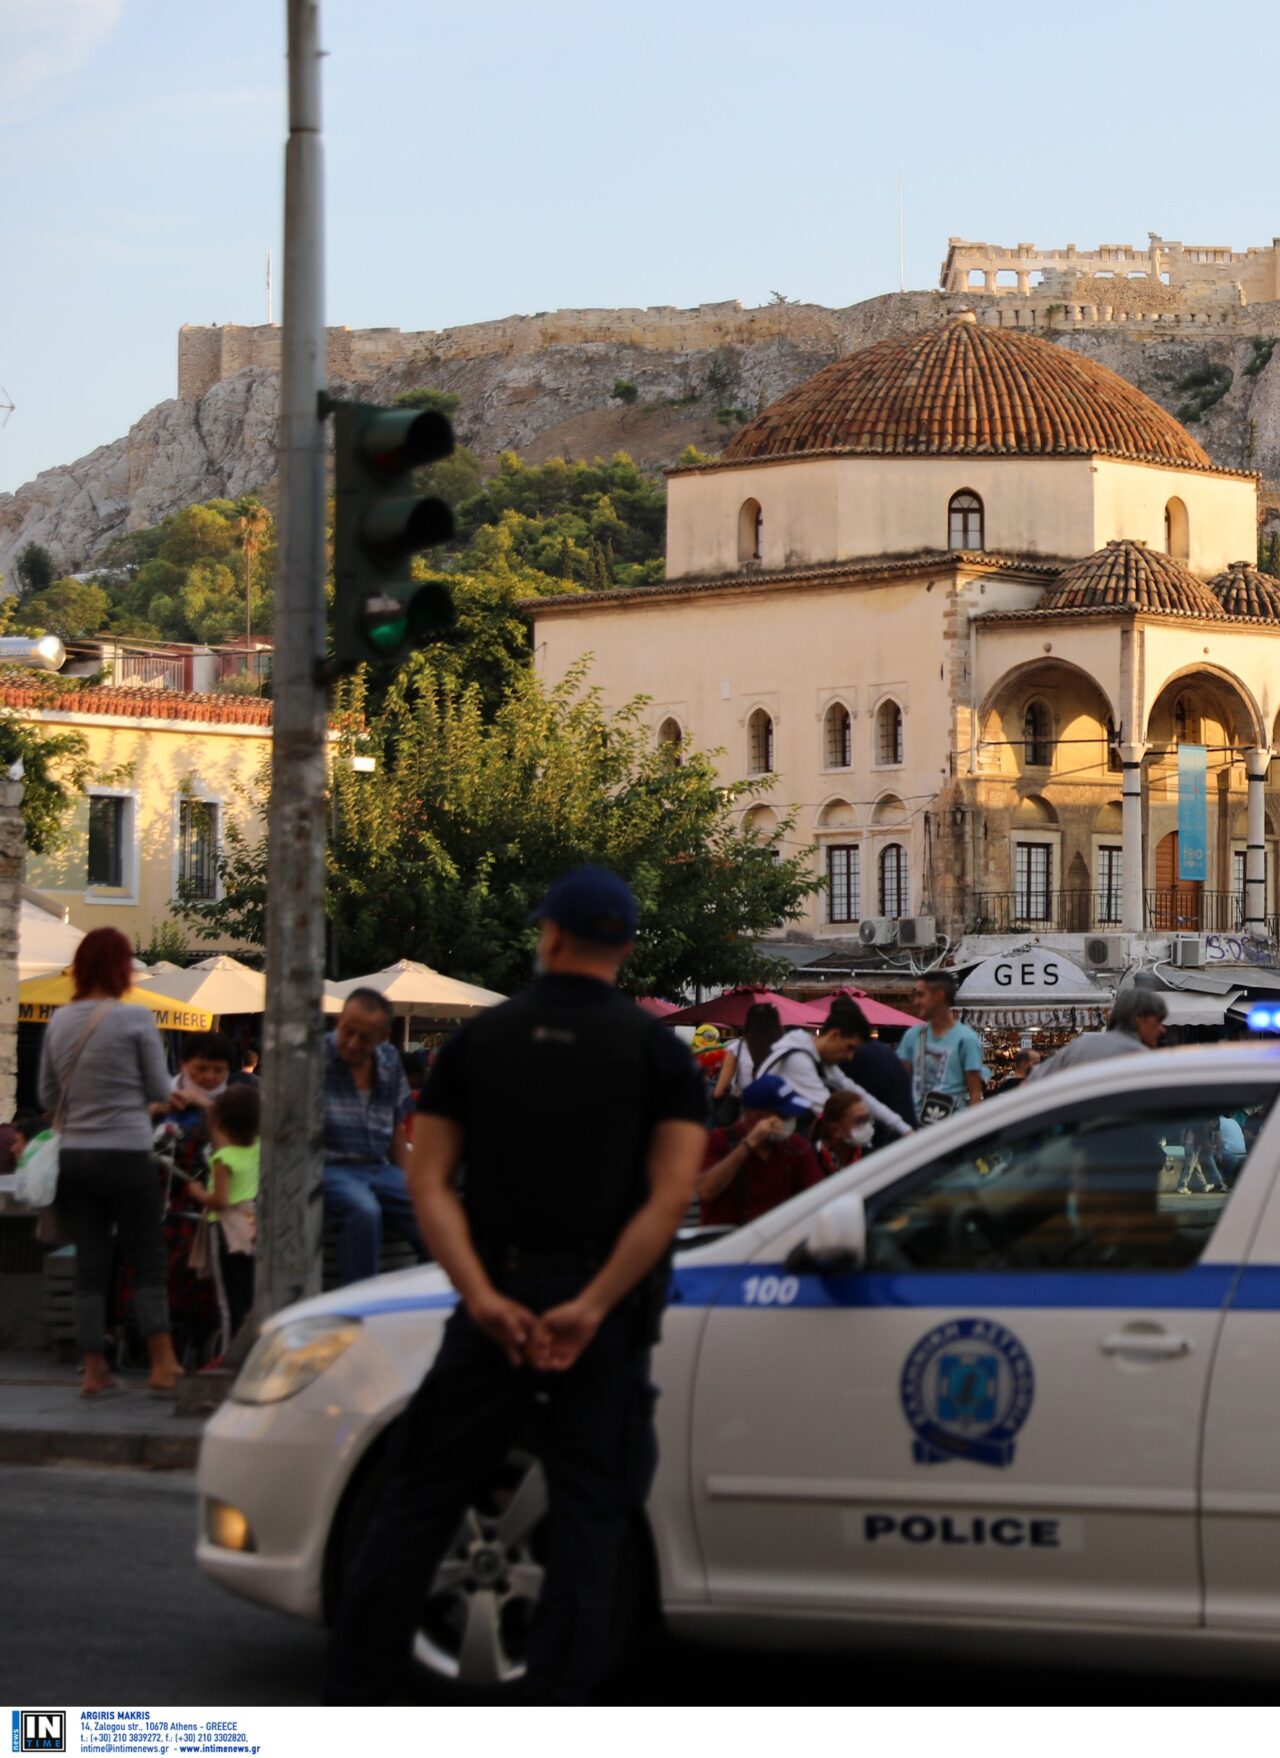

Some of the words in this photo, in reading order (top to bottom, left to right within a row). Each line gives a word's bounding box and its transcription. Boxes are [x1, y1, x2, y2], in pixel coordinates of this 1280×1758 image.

[994, 963, 1059, 986] GES
[173, 1011, 207, 1028] HERE
[742, 1275, 799, 1305] 100
[864, 1514, 1060, 1547] POLICE
